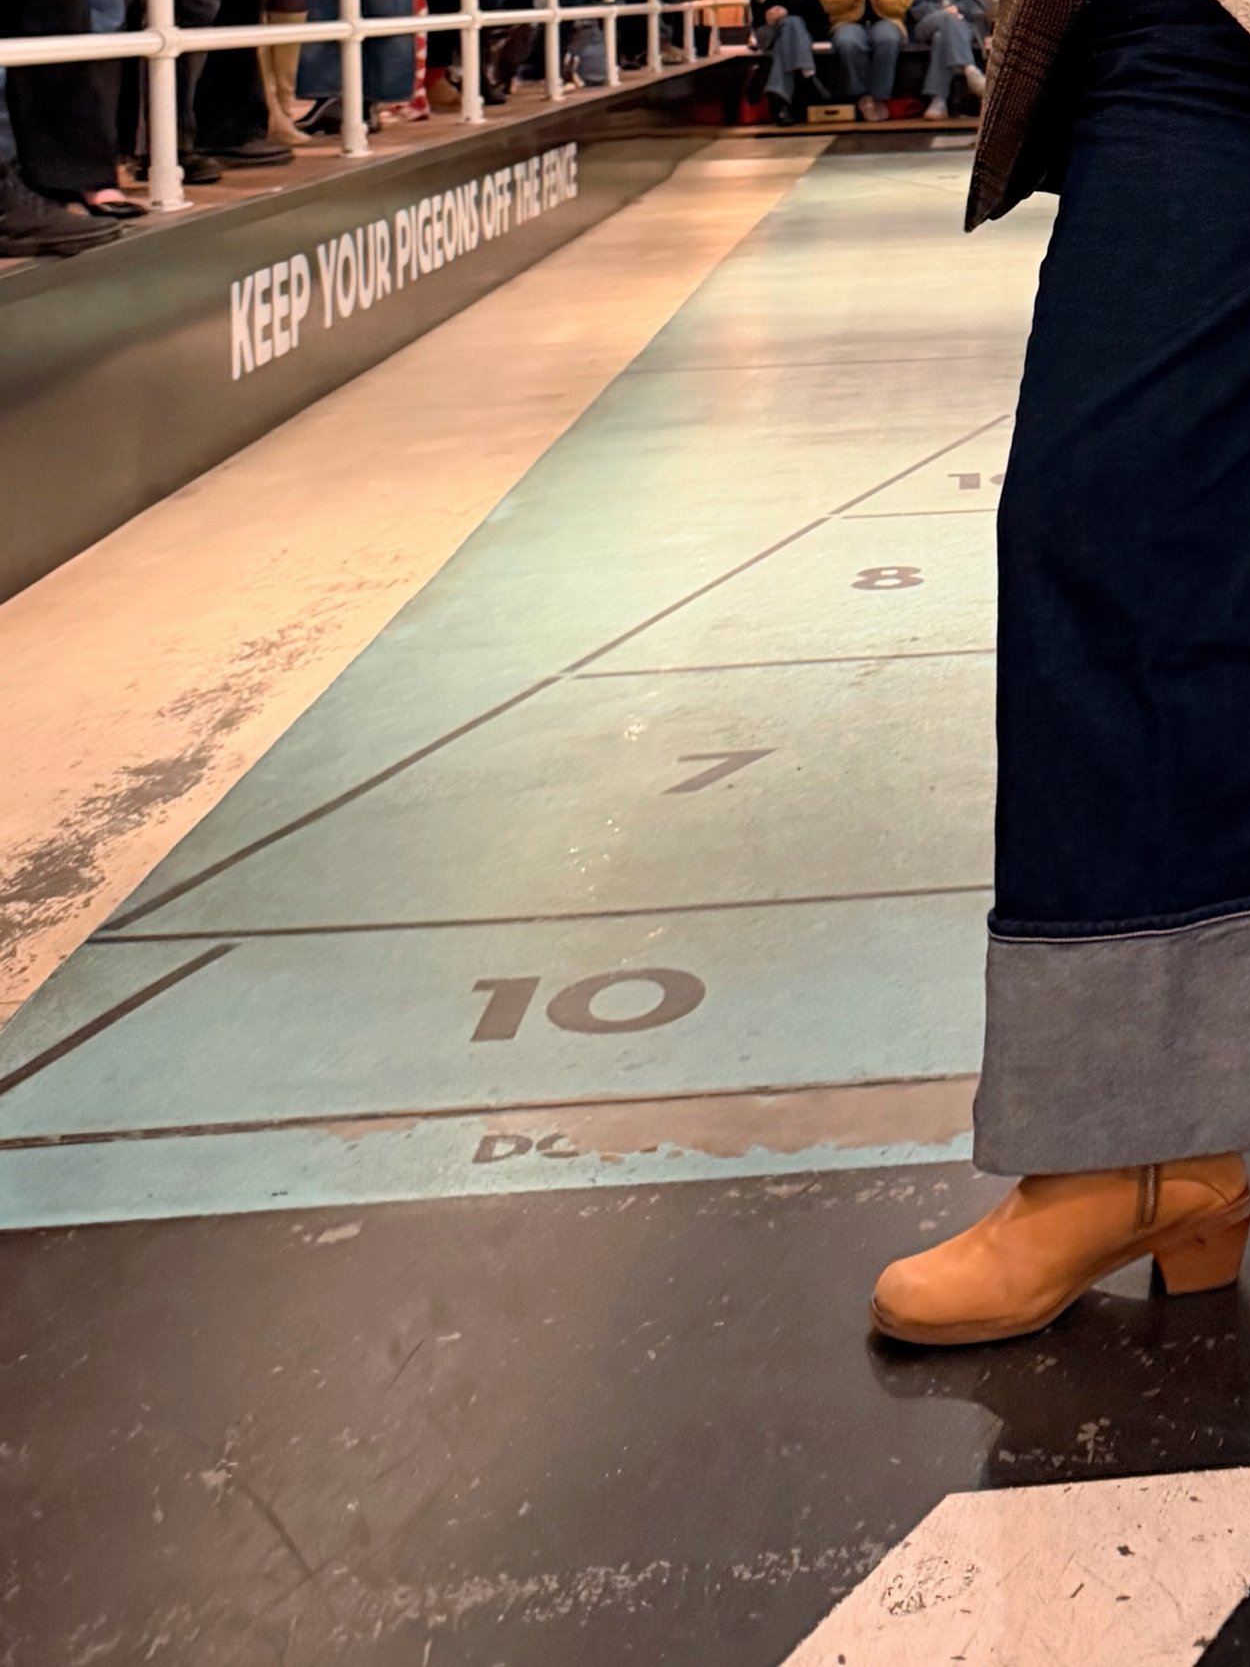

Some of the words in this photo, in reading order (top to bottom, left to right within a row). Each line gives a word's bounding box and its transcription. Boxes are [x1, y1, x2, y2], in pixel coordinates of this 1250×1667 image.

[231, 253, 311, 381] KEEP
[317, 219, 391, 329] YOUR
[395, 179, 480, 290] PIGEONS
[481, 166, 512, 241] OFF
[513, 155, 541, 226] THE
[541, 141, 578, 211] FENCE
[948, 472, 1004, 490] 1
[851, 565, 924, 590] 8
[661, 747, 780, 794] 7
[470, 967, 706, 1042] 10
